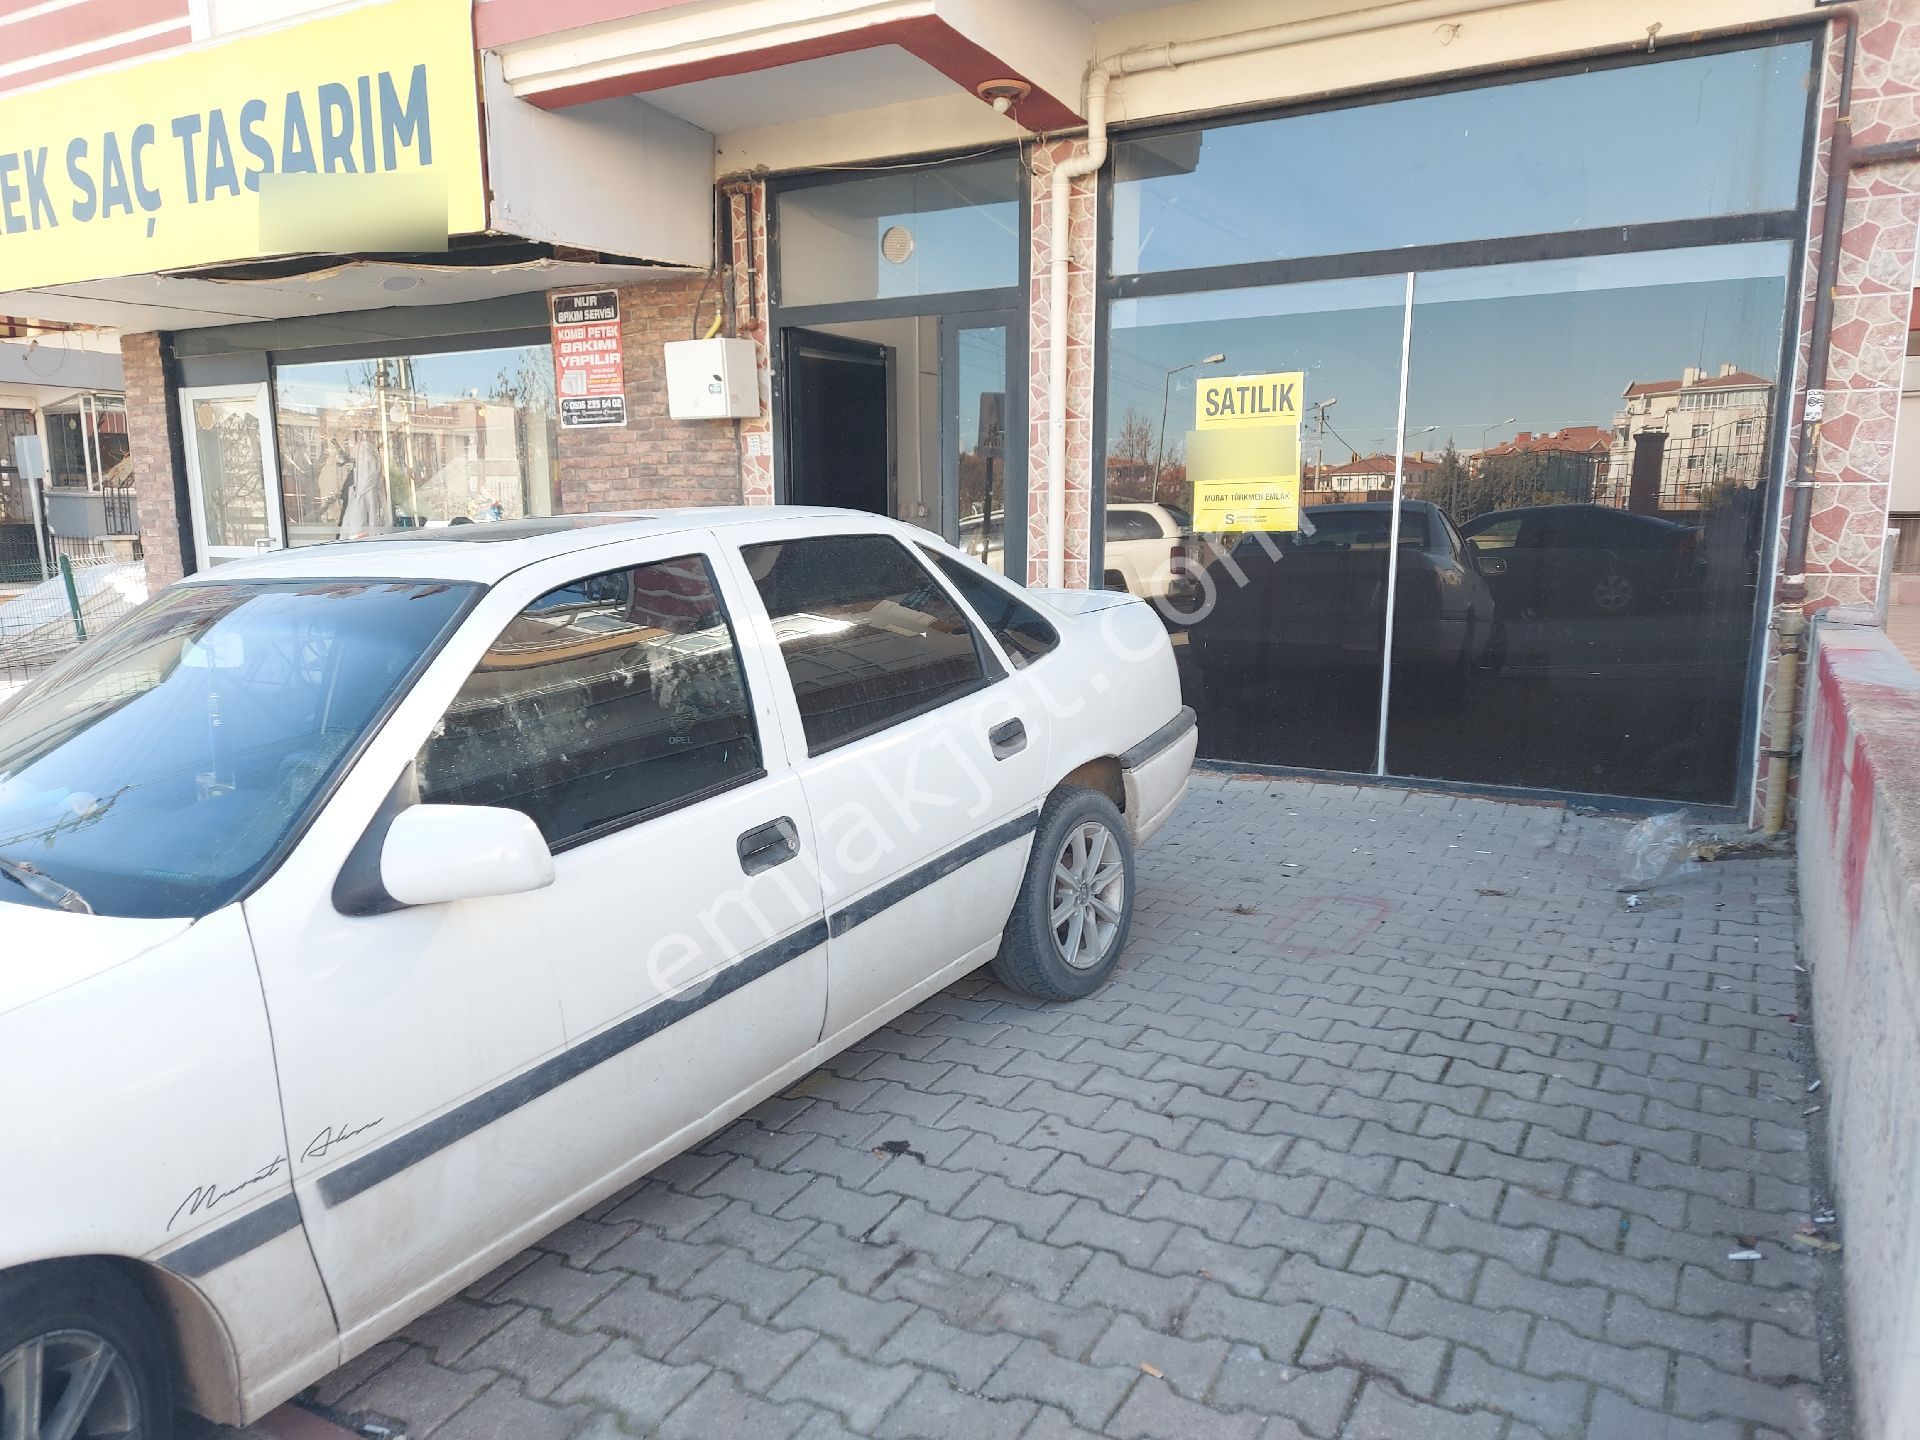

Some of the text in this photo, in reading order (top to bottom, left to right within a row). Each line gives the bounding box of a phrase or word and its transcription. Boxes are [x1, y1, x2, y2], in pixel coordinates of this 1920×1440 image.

[0, 63, 432, 238] EK SAÇ TASARIM
[574, 296, 597, 307] NUR
[558, 306, 614, 322] BAKIM SERVİSİ
[558, 325, 618, 340] KOMBİ PETEK
[561, 339, 617, 353] BAKIMI
[559, 353, 620, 367] YAPILIR
[1205, 383, 1295, 416] SATILIK
[1231, 493, 1264, 502] TÜRKMEN
[1265, 492, 1290, 501] EMLAK
[669, 736, 694, 745] OPEL
